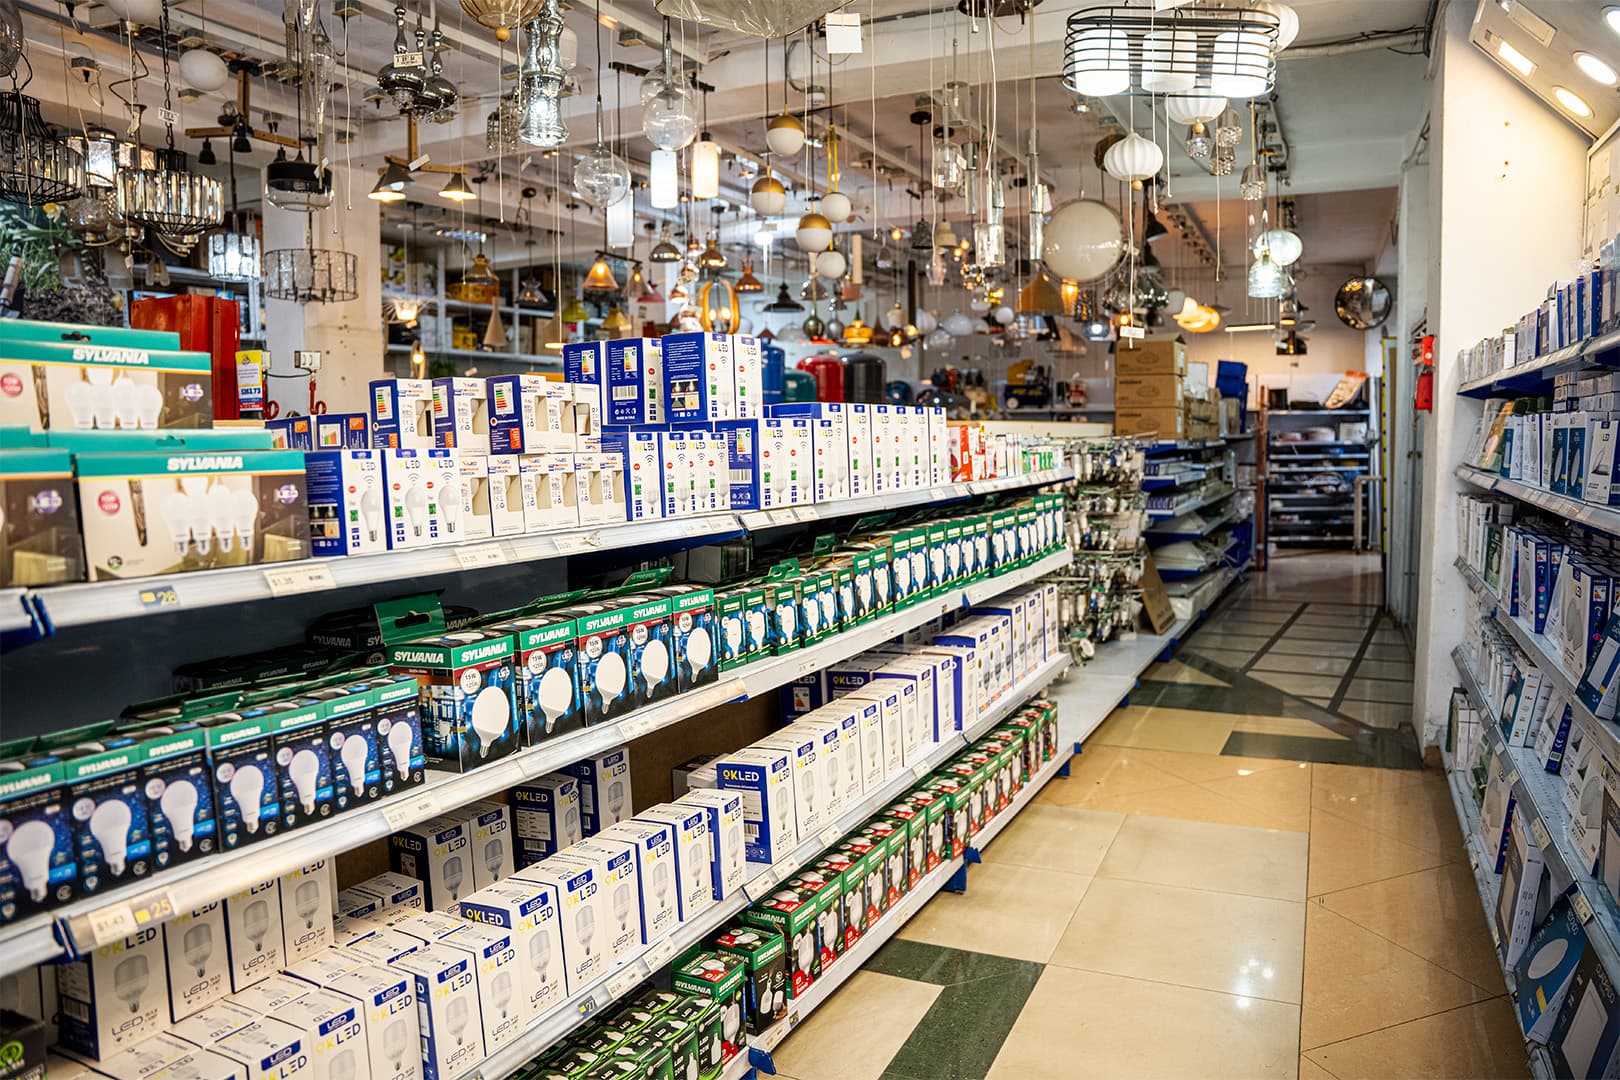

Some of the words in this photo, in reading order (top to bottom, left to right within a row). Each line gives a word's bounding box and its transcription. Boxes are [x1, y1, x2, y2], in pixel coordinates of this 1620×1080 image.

[73, 348, 149, 364] SYLVANIA
[167, 456, 243, 471] SYLVANIA
[156, 590, 177, 605] 28
[680, 593, 710, 607] SYLVANIA
[633, 604, 667, 618] SYLVANIA
[586, 613, 624, 630] SYLVANIA
[529, 626, 570, 644] SYLVANIA
[394, 651, 444, 663] SYLVANIA
[461, 642, 507, 662] SYLVANIA
[723, 769, 760, 782] OKLED
[515, 791, 548, 803] OKLED
[645, 842, 670, 864] OKLED
[605, 862, 634, 886] OKLED
[526, 898, 542, 909] LED
[566, 882, 597, 908] OKLED
[149, 893, 172, 917] 25
[466, 909, 504, 926] OKLED
[518, 906, 553, 934] OKLED
[294, 931, 316, 946] LED
[242, 955, 266, 971] LED
[481, 949, 515, 974] OKLED
[183, 981, 209, 998] LED
[381, 985, 399, 998] LED
[435, 973, 472, 1000] OKLED
[675, 980, 711, 995] SYLVANIA
[371, 995, 413, 1022] OKLED
[112, 1016, 144, 1036] LED
[327, 1015, 347, 1028] LED
[316, 1023, 361, 1055] OKLED
